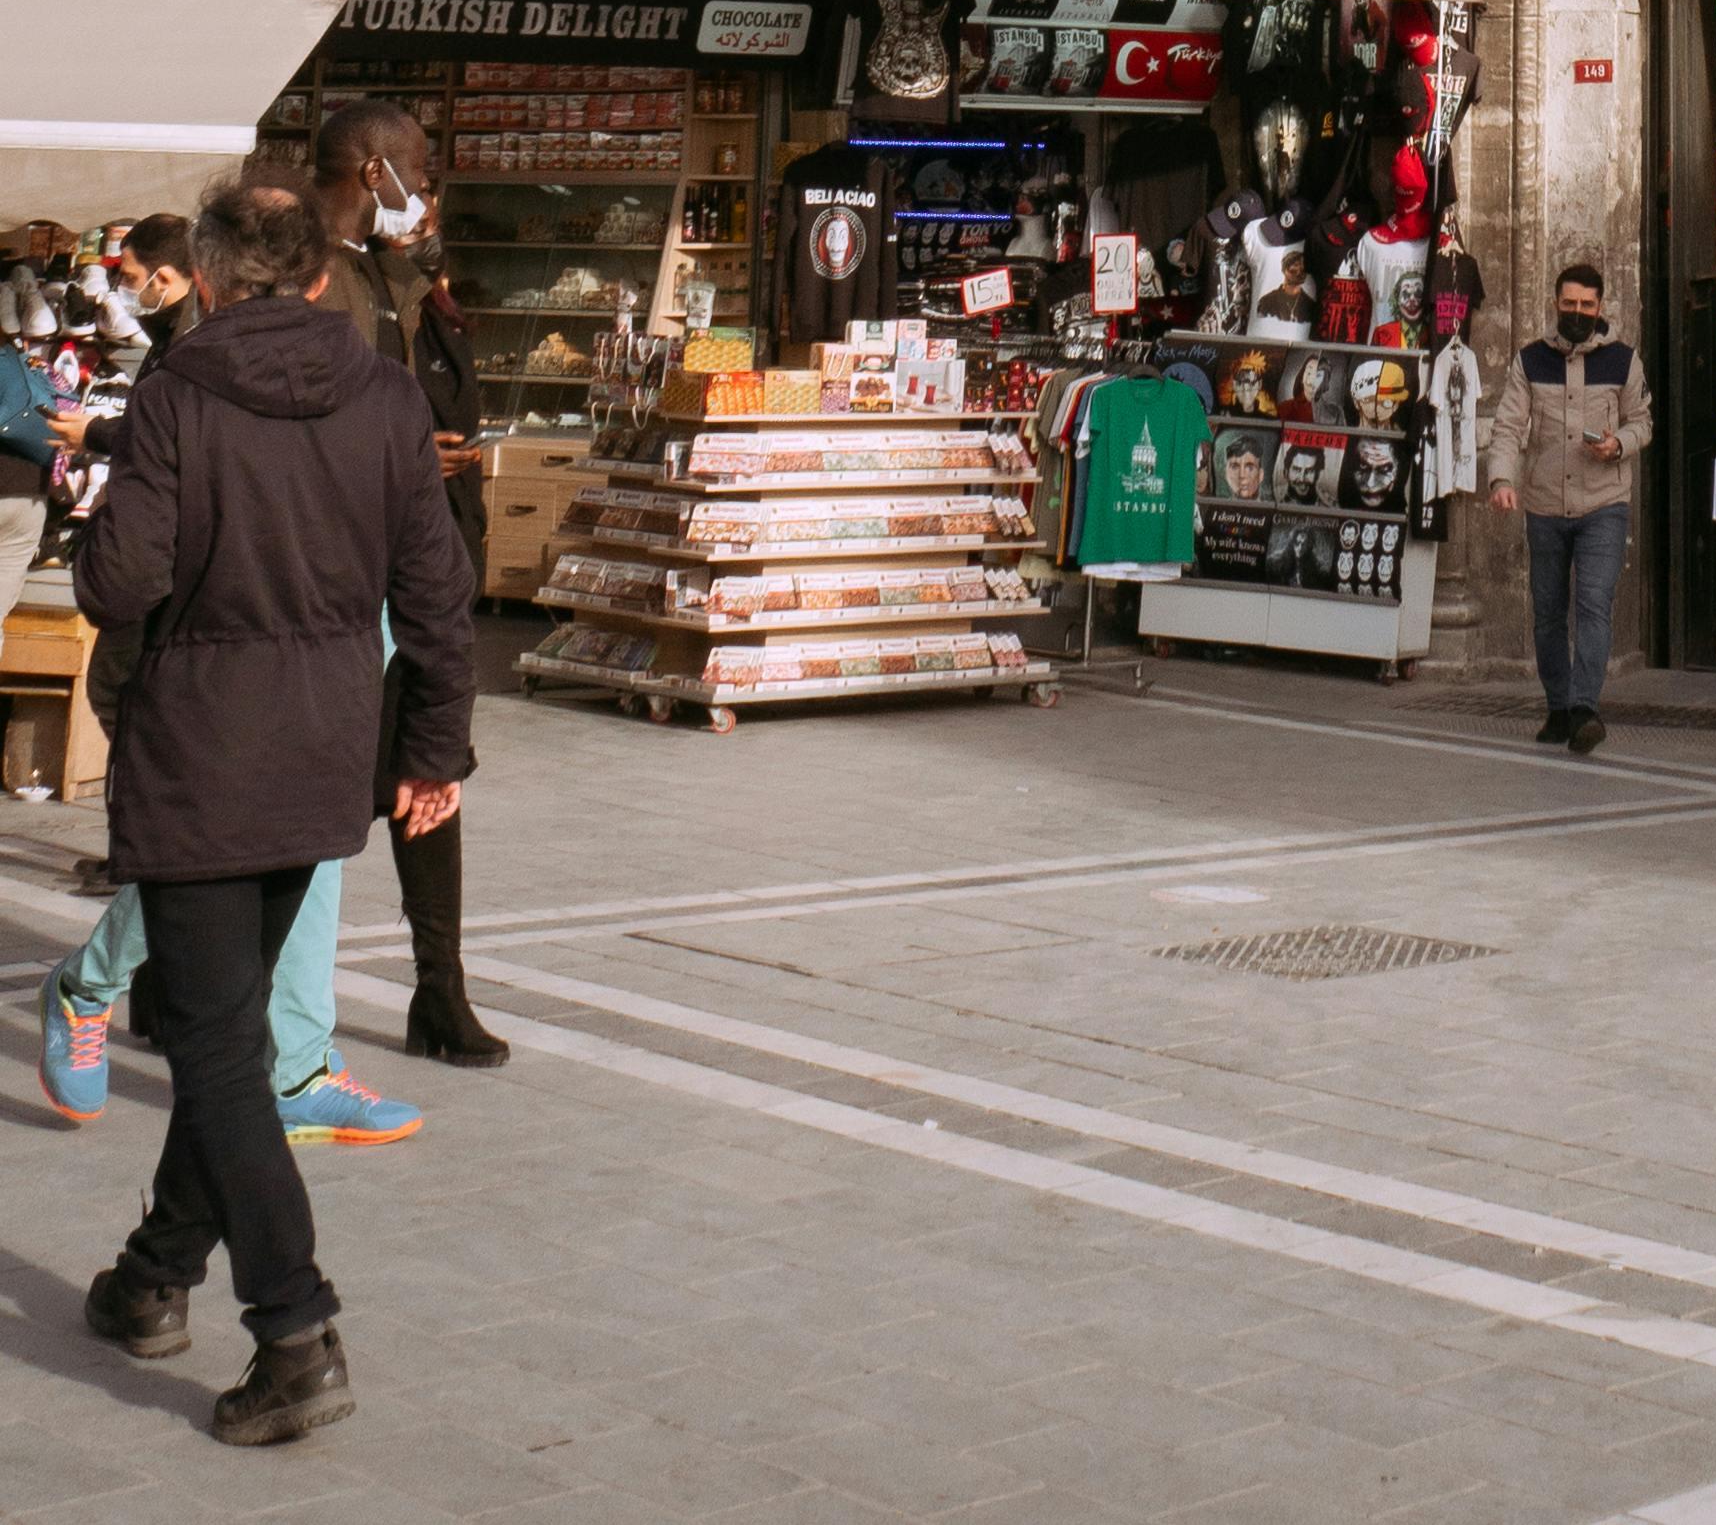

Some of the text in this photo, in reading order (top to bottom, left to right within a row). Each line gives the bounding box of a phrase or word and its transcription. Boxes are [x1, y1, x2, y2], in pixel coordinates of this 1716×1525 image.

[520, 1, 689, 41] DELIGHT
[711, 10, 803, 29] CHOCOLATE
[1097, 241, 1131, 275] 20
[970, 277, 994, 306] 15
[1242, 515, 1266, 527] need
